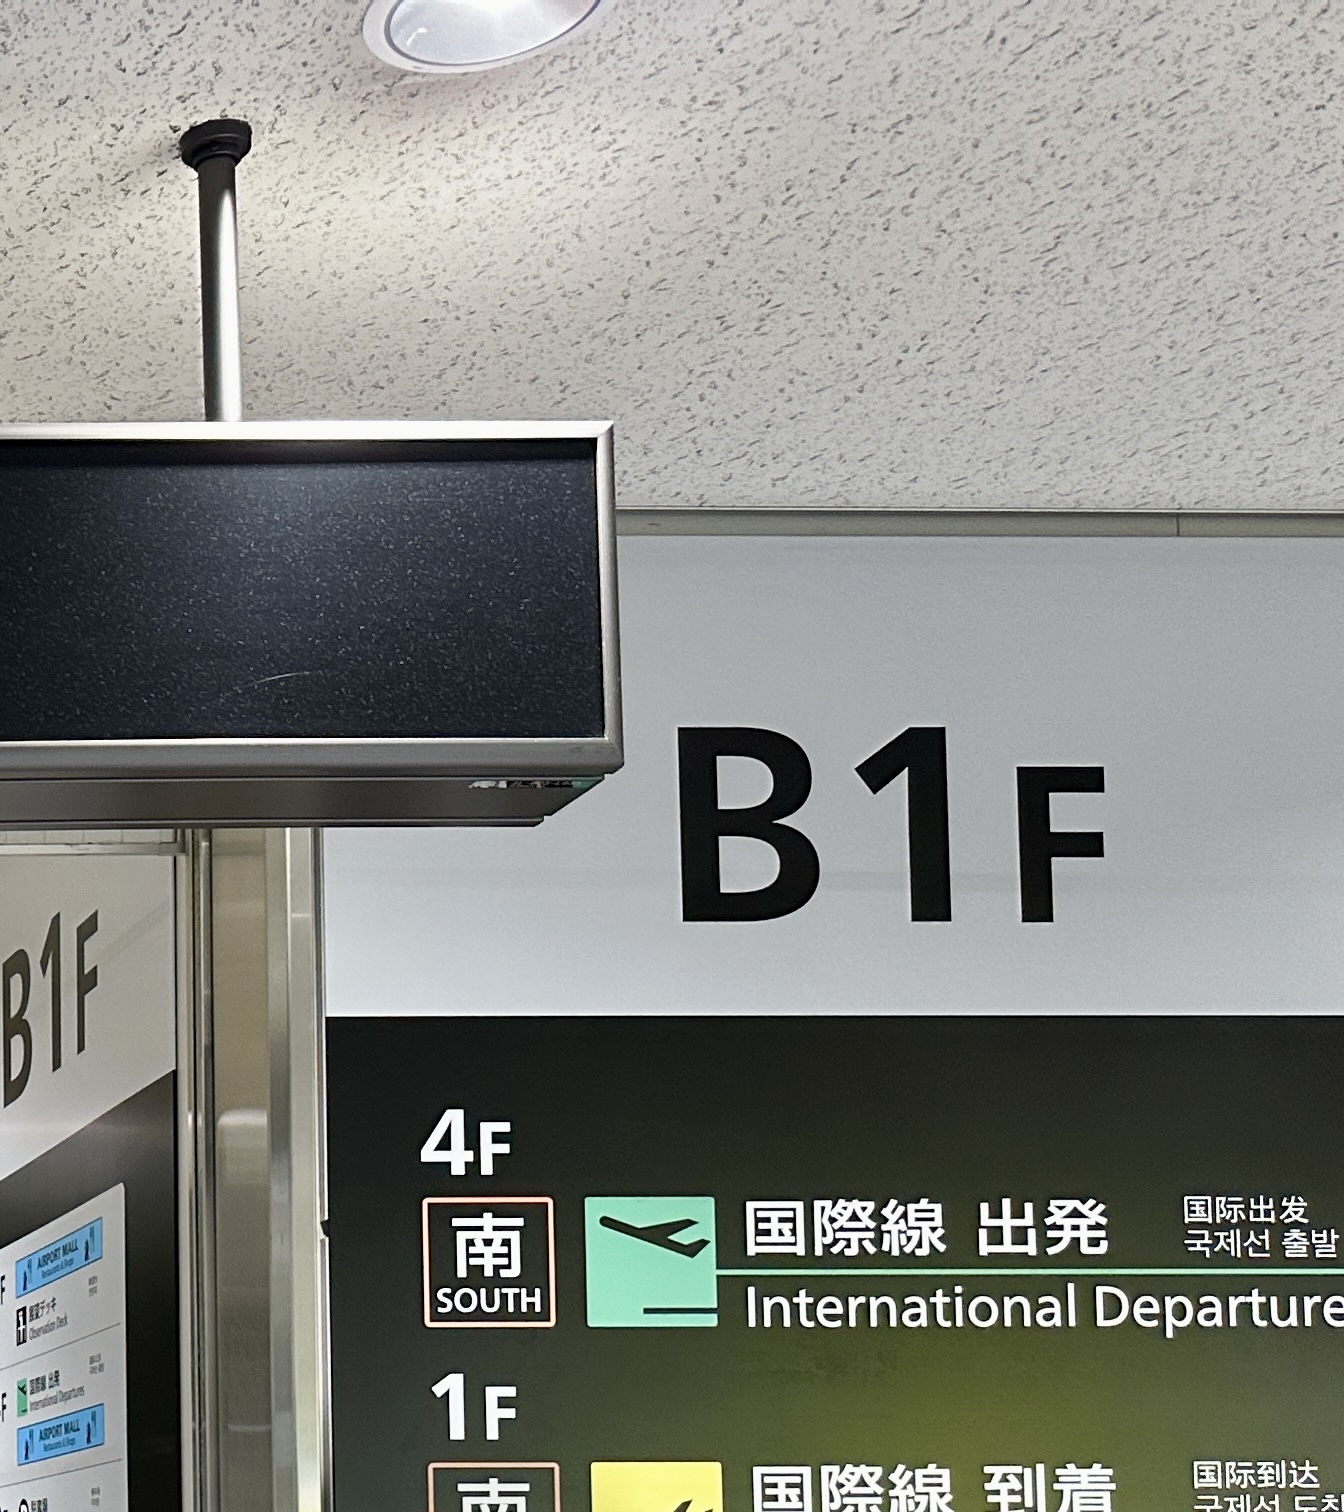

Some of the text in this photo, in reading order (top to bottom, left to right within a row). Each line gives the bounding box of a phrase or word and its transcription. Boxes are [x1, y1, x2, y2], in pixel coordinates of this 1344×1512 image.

[677, 726, 1105, 923] B1F
[2, 909, 99, 1109] B1F
[421, 1109, 511, 1176] 4F
[744, 1199, 1110, 1257] 国際線 出発
[1183, 1195, 1309, 1224] 国际出发
[451, 1213, 525, 1278] 南
[1183, 1229, 1340, 1258] 국제선 출발
[436, 1287, 542, 1314] SOUTH
[746, 1286, 1077, 1329] International
[430, 1373, 518, 1441] 1F
[1193, 1460, 1321, 1489] 国际到达
